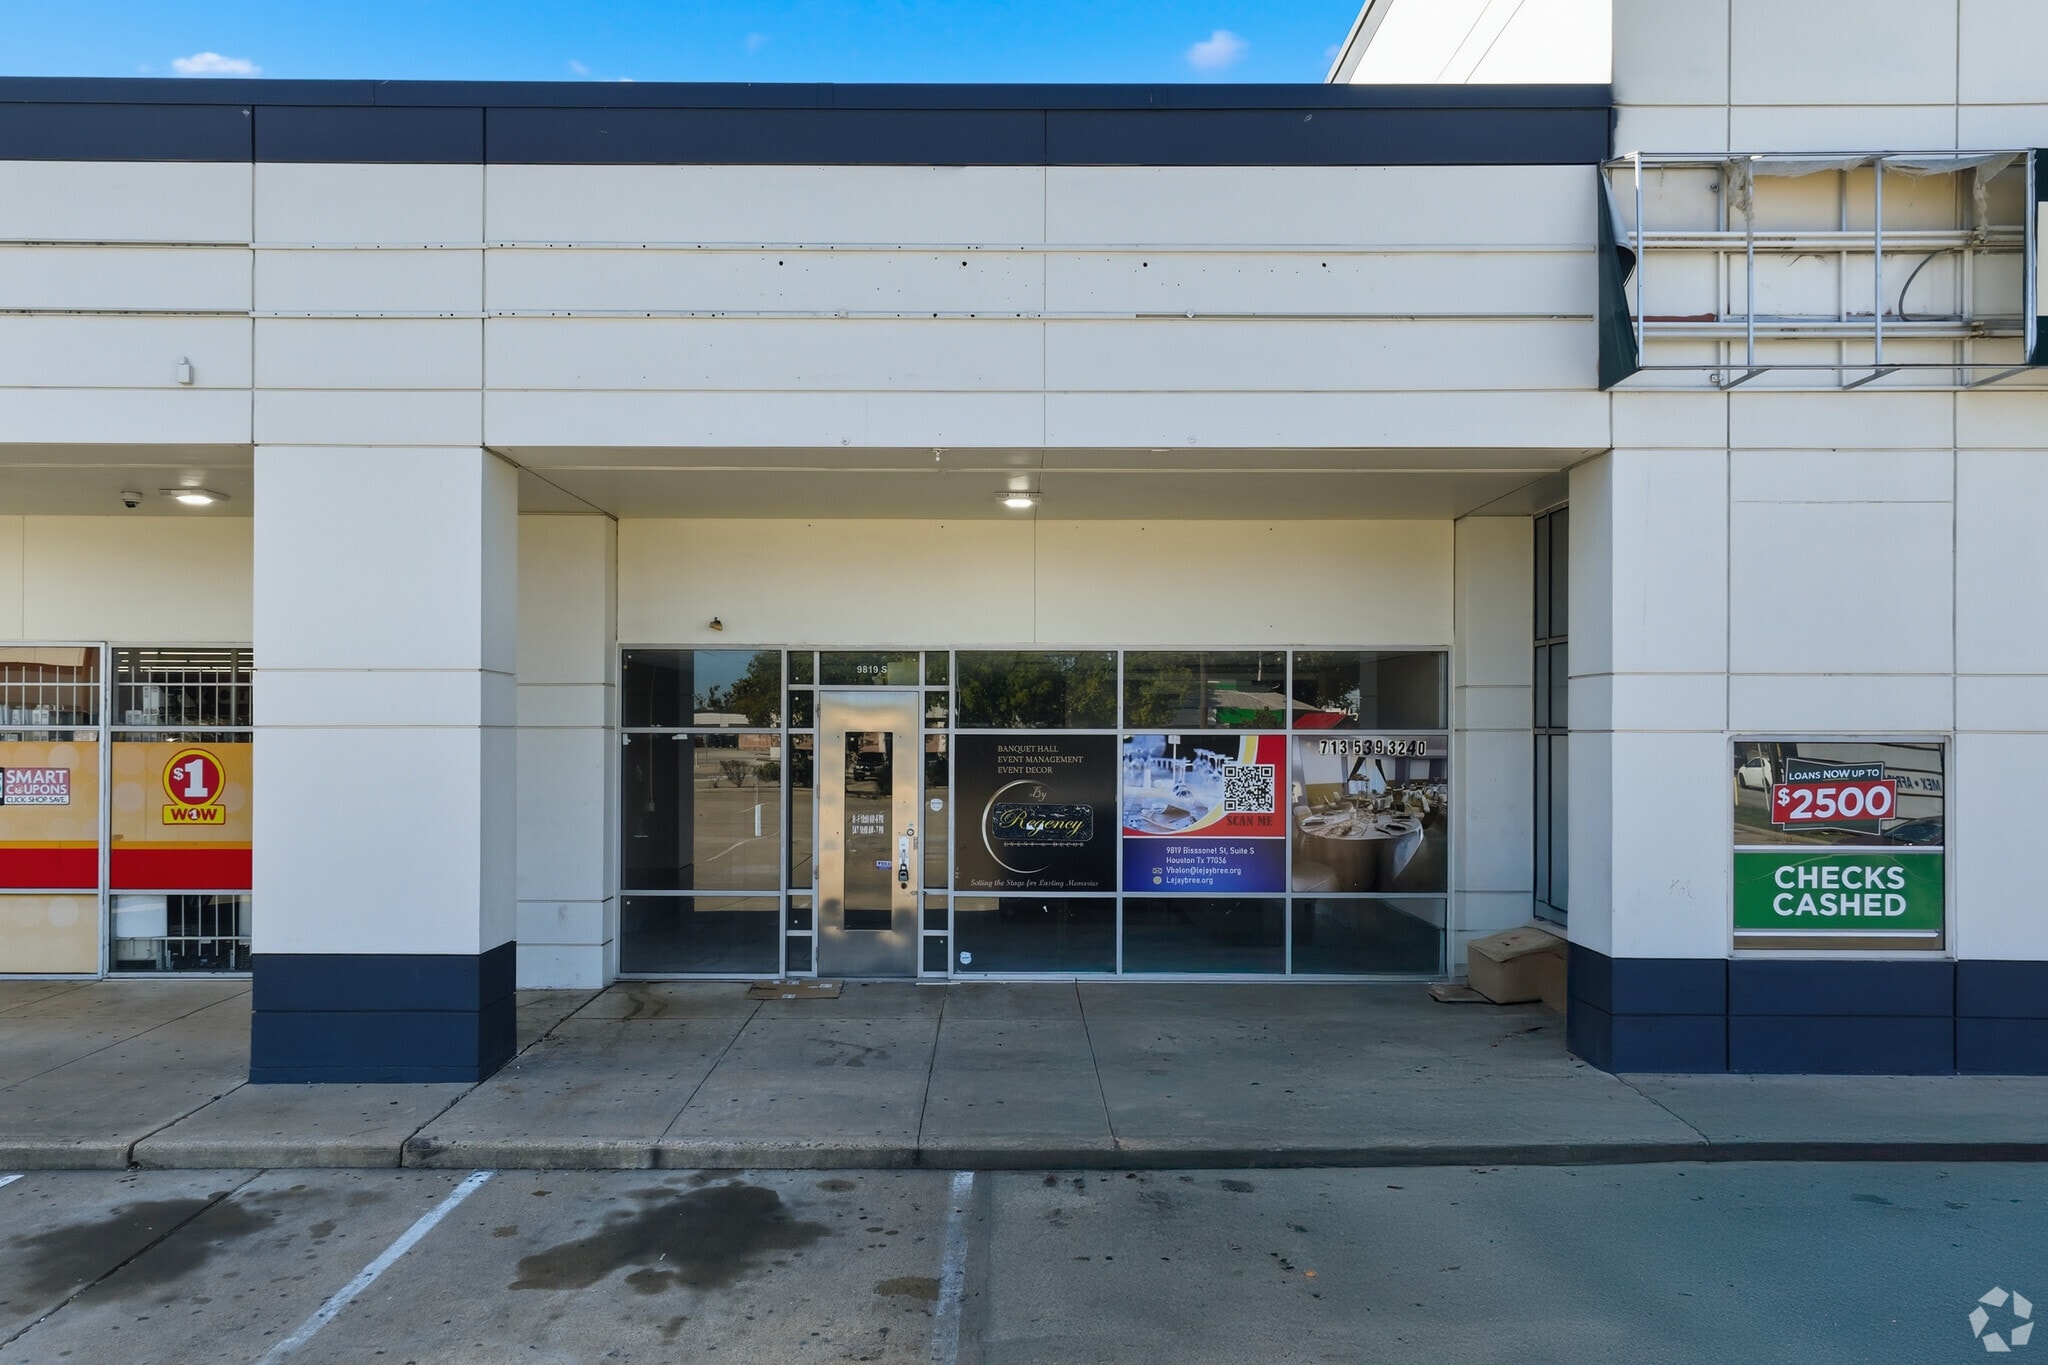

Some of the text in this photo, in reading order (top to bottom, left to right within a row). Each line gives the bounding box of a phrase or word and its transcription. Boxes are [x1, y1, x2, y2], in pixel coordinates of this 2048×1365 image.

[856, 665, 888, 674] 9819 S
[997, 745, 1035, 754] BANQUET
[1320, 739, 1426, 755] 713 539 3240
[6, 770, 67, 784] SMART
[1789, 769, 1880, 781] LOANS NOW UP TO
[6, 784, 67, 795] COUPONS
[1029, 786, 1047, 801] By
[1777, 785, 1892, 819] $2500
[999, 808, 1084, 838] Regency
[1227, 816, 1273, 826] SCAN ME
[1166, 846, 1181, 854] 9819
[1229, 847, 1248, 855] Suite
[1249, 847, 1255, 855] S
[1005, 879, 1025, 888] Stage
[1026, 879, 1037, 888] for
[1038, 879, 1064, 888] Lasting
[1774, 866, 1906, 890] CHECKS
[1772, 893, 1907, 917] CASHED
